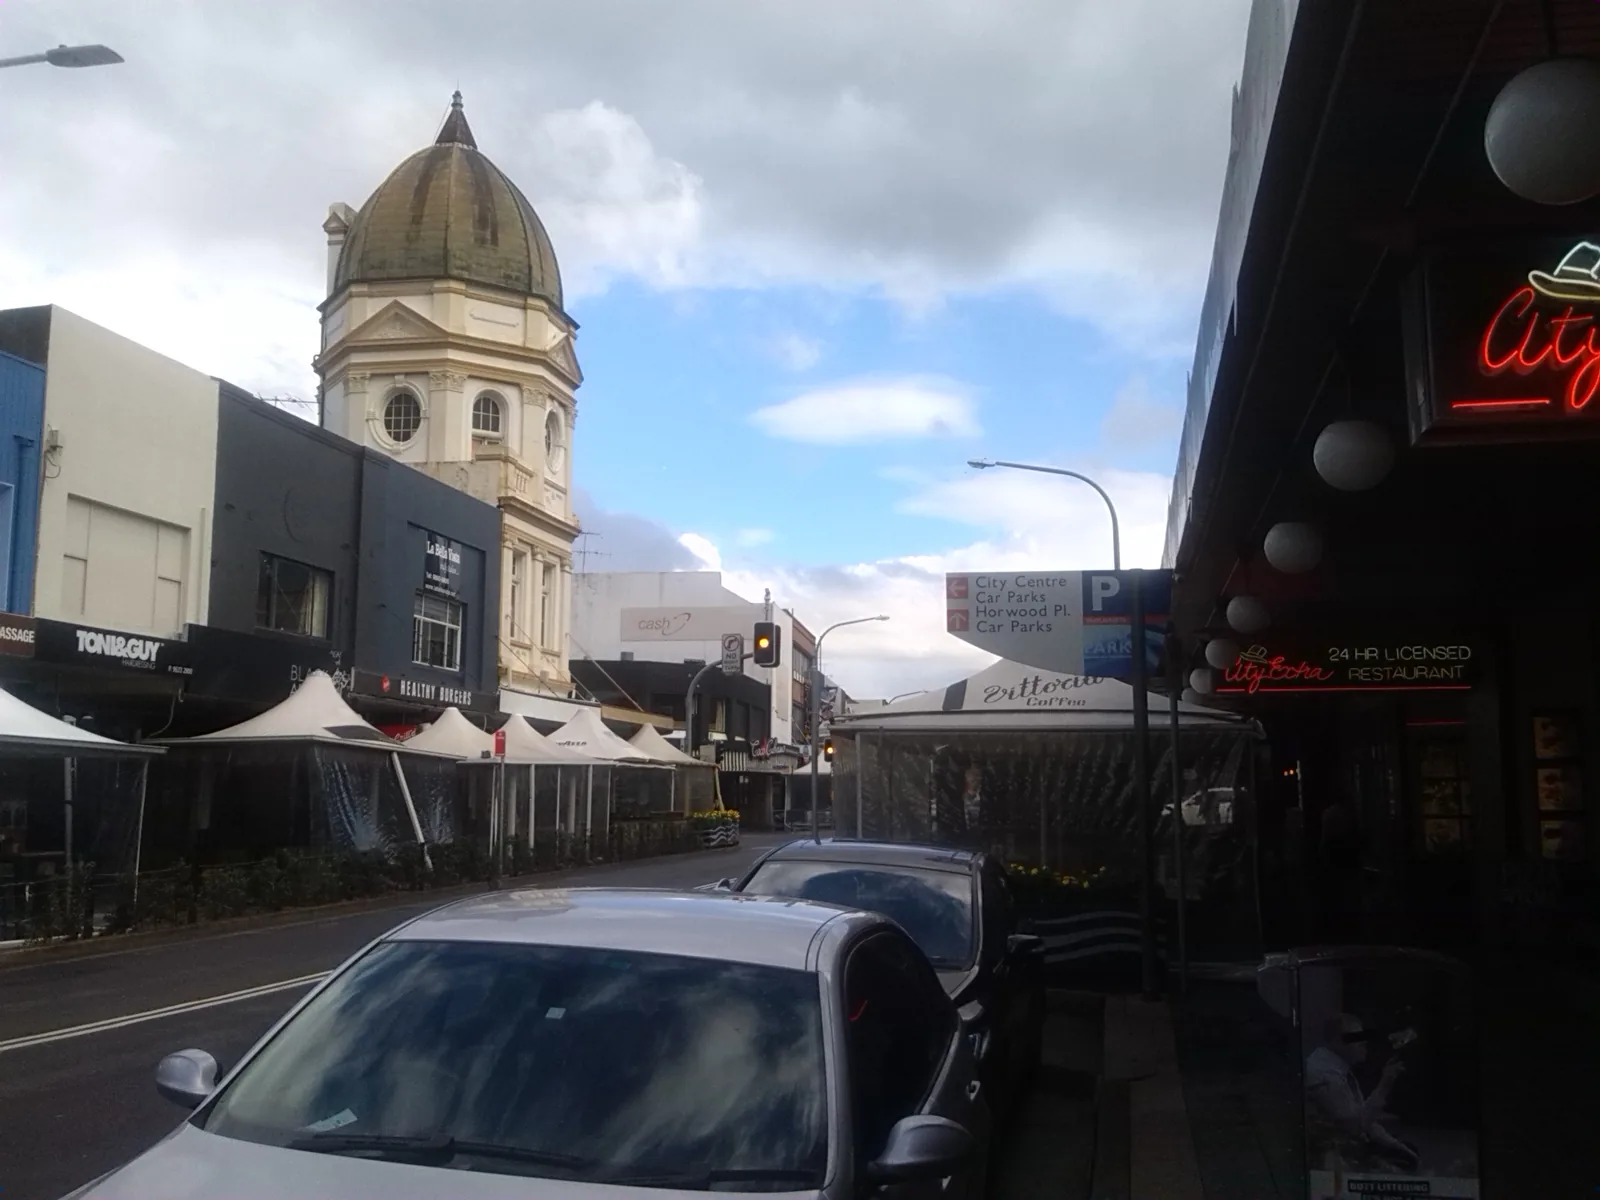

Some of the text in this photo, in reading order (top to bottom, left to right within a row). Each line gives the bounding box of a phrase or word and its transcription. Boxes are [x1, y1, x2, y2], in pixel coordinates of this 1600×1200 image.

[975, 575, 1068, 592] City Centre
[975, 590, 1047, 604] Car Parks
[1091, 575, 1121, 612] P
[975, 604, 1072, 618] Horwood Pl.
[638, 616, 671, 631] cash
[976, 620, 1053, 633] Car Parks
[0, 626, 35, 644] ASSAGE
[76, 630, 161, 662] TONI&GUY
[1327, 645, 1472, 662] 24 HR LICENSED
[725, 652, 737, 660] NO
[1348, 664, 1465, 682] RESTAURANT
[400, 679, 436, 701] HEALTHY
[440, 687, 472, 707] BURGERS
[1026, 696, 1086, 707] Coffee
